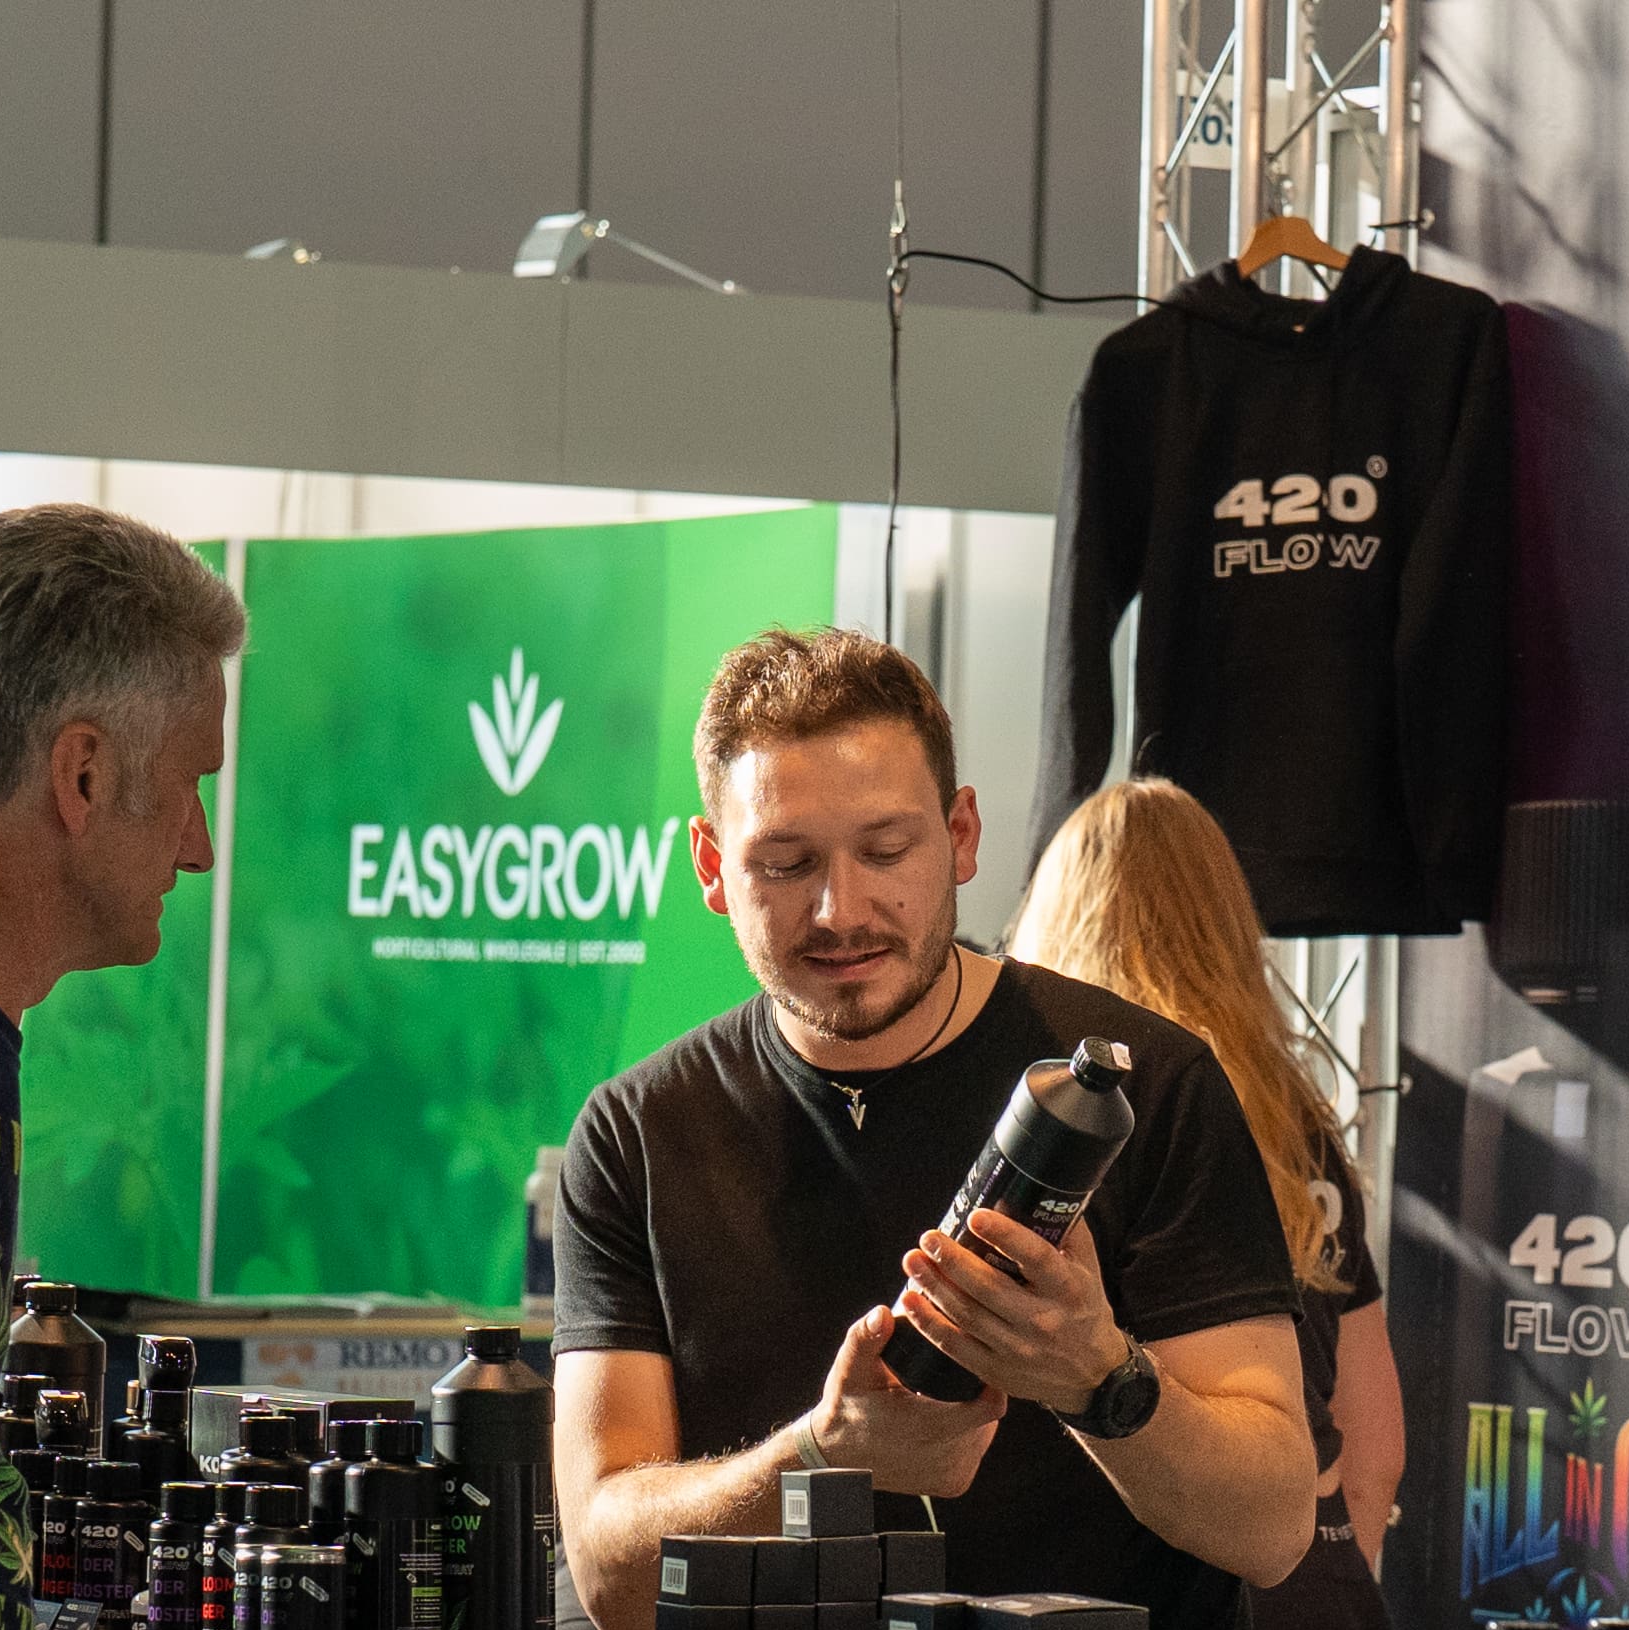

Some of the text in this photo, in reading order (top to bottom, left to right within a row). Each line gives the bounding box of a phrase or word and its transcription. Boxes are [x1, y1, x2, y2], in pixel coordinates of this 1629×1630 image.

[1214, 534, 1381, 577] FLOW
[1039, 1198, 1080, 1214] 420
[337, 1337, 451, 1369] REMO
[1461, 1402, 1560, 1599] ALL
[81, 1524, 119, 1539] 420
[152, 1545, 189, 1559] 420
[83, 1558, 115, 1573] DER
[155, 1579, 186, 1595] DER
